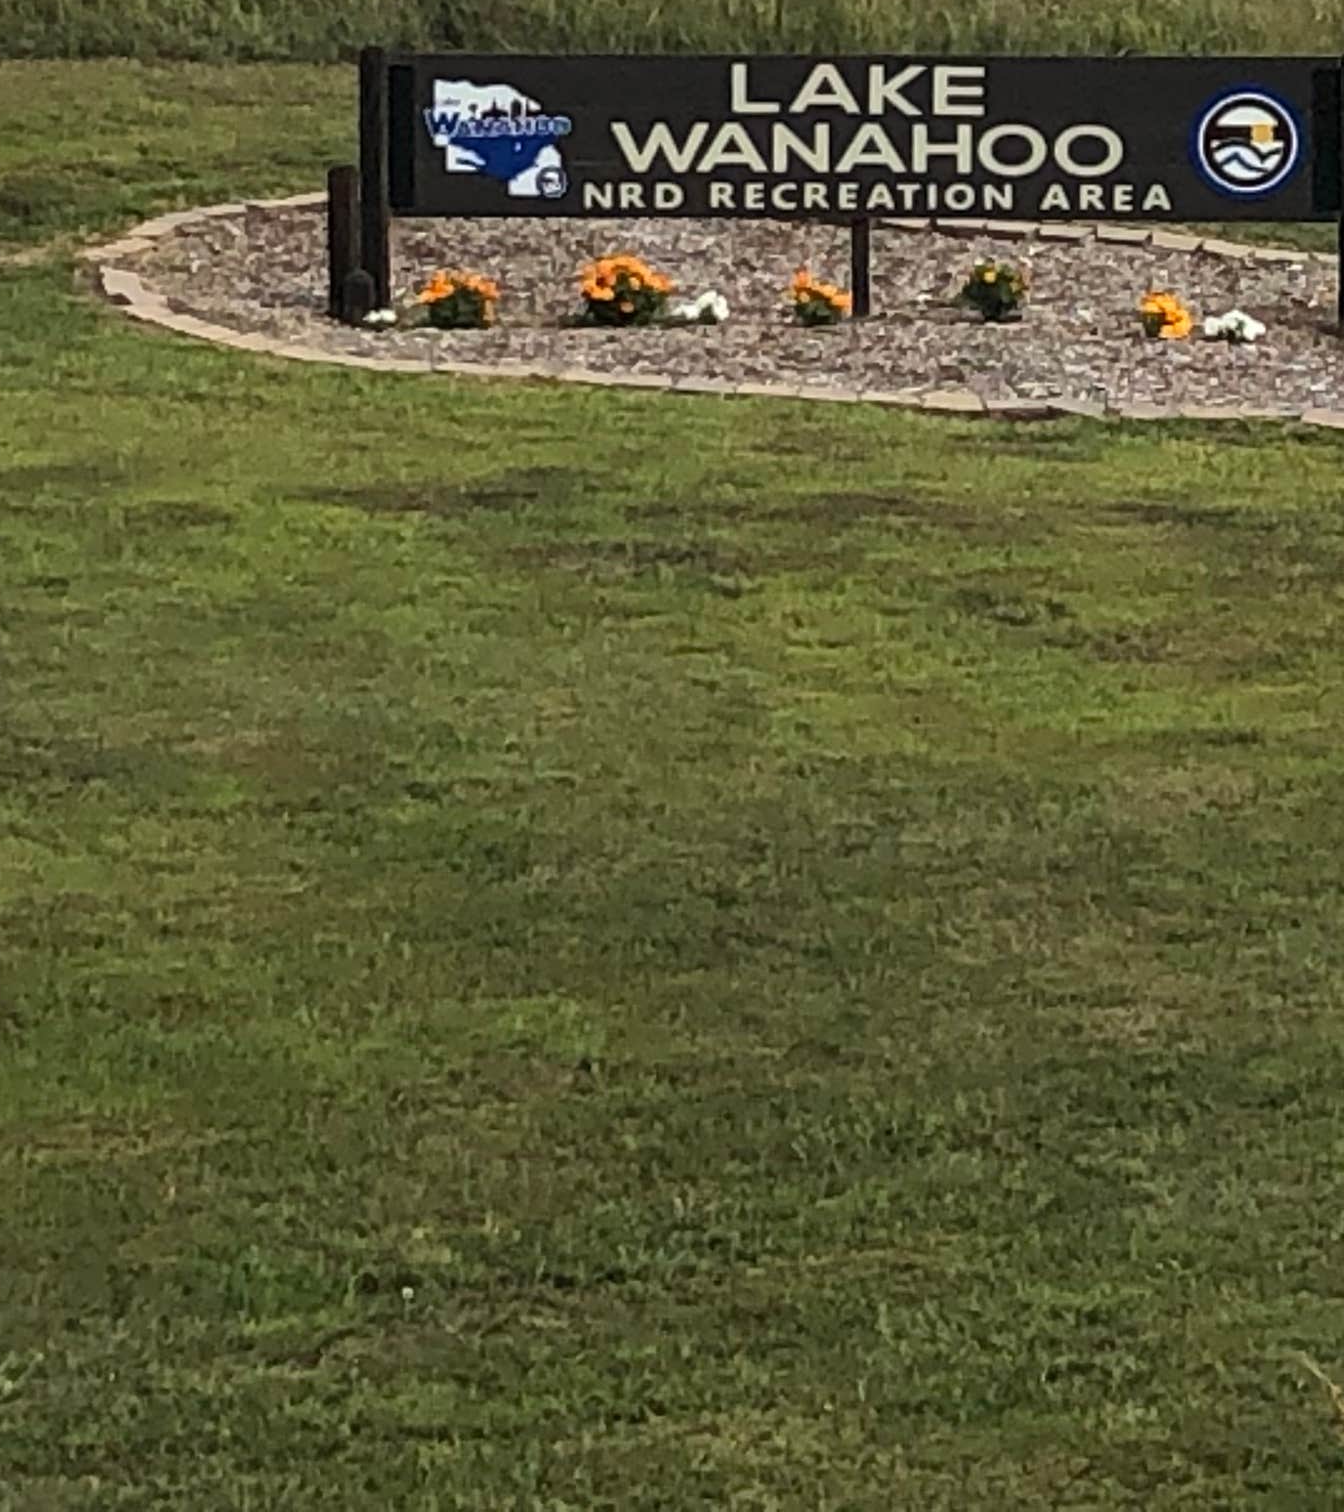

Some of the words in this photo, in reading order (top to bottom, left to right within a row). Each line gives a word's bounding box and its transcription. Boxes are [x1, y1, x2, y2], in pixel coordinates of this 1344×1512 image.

[731, 63, 985, 116] LAKE
[611, 122, 1123, 177] WANAHOO
[584, 182, 684, 209] NRD
[710, 182, 1013, 211] RECREATION
[1040, 184, 1171, 212] AREA
